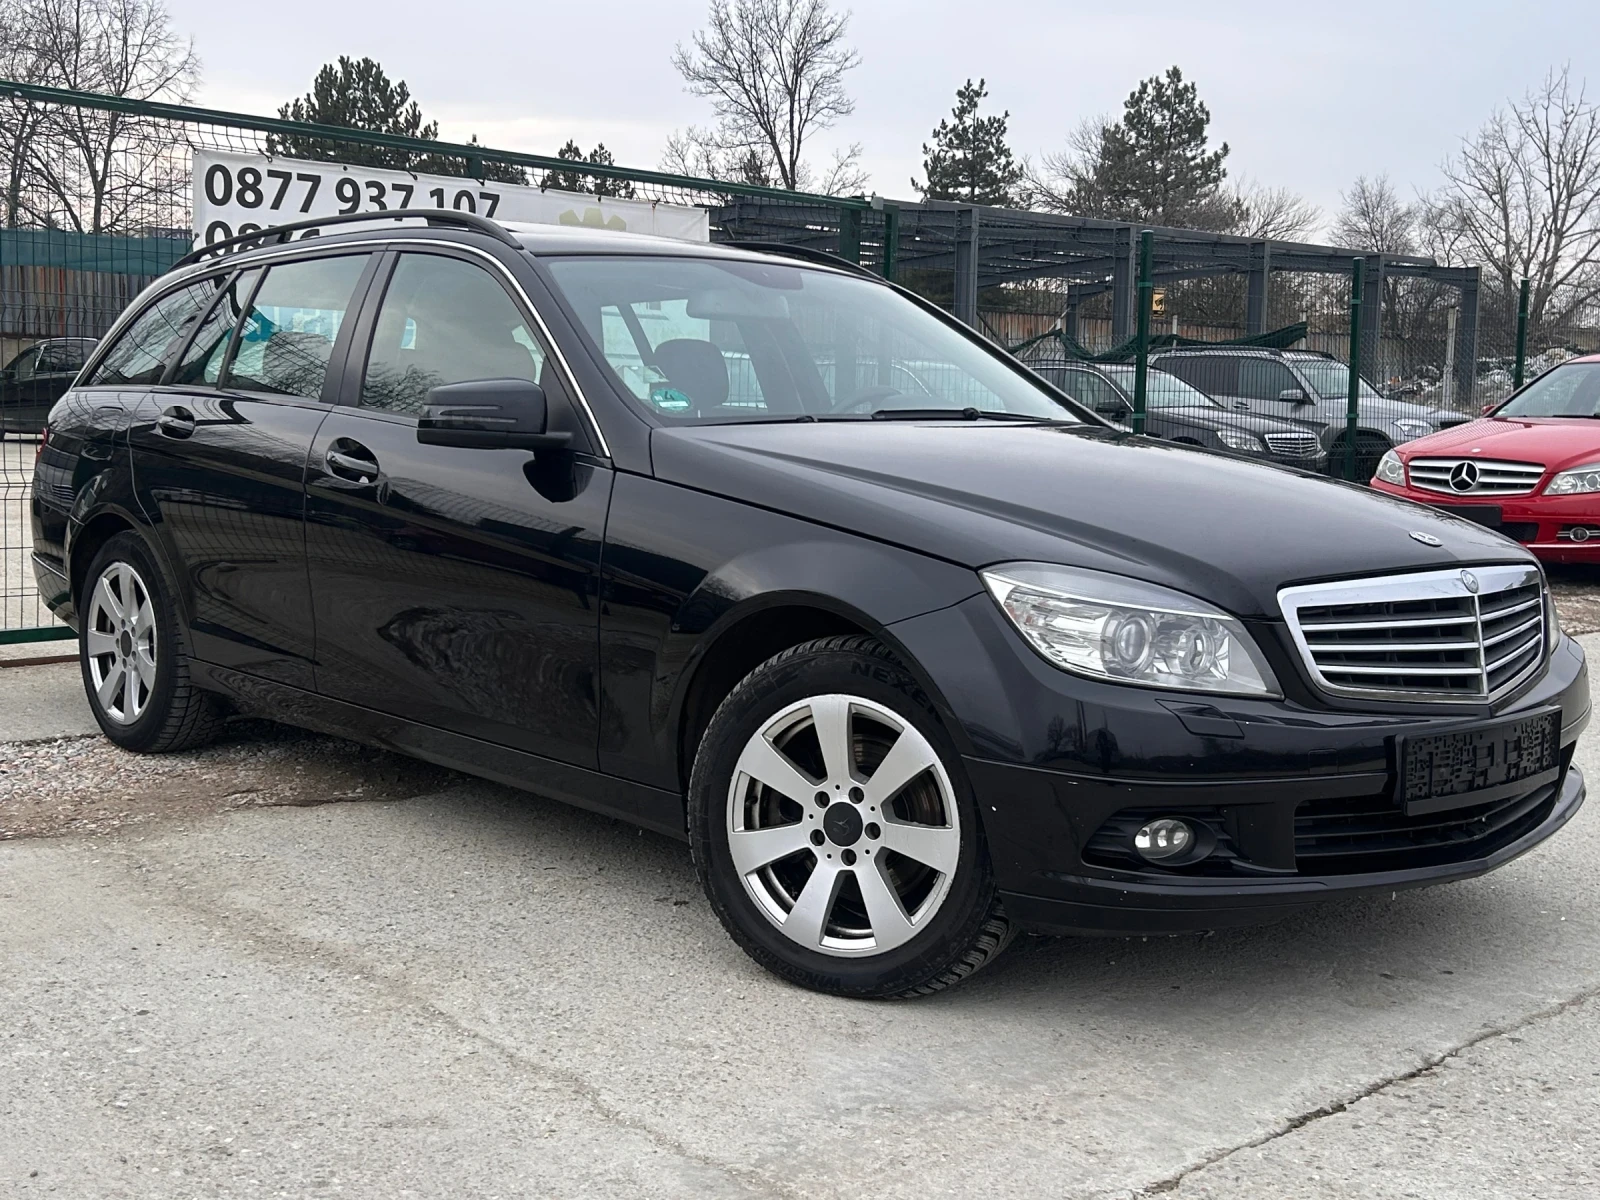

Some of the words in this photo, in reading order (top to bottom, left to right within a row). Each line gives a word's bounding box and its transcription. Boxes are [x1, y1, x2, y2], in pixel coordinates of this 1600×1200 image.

[205, 164, 321, 213] 0877
[335, 177, 414, 221] 937
[430, 188, 501, 219] 107
[205, 221, 320, 258] 08
[664, 390, 675, 401] 4
